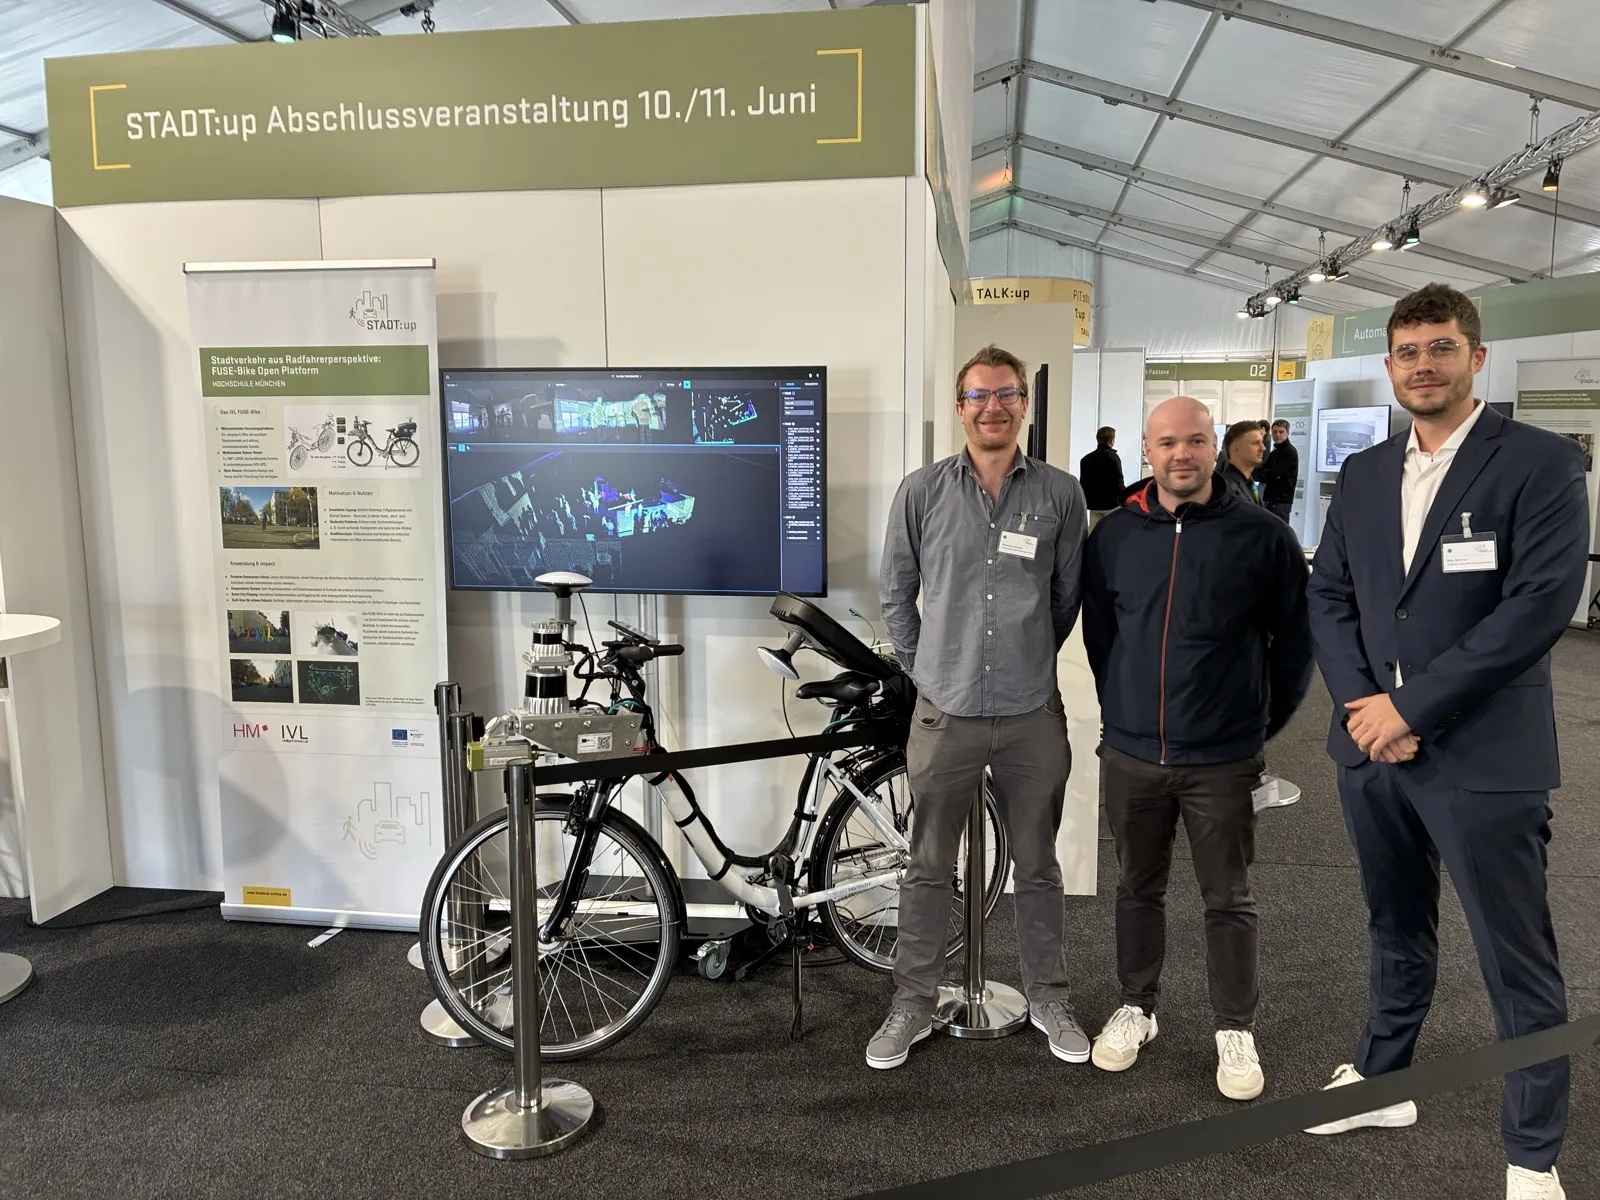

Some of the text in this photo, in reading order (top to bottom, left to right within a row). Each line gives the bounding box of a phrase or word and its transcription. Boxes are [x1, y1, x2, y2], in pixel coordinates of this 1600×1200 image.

[126, 83, 817, 142] STADT:up Abschlussveranstaltung 10./11. Juni
[976, 287, 1030, 301] TALK:up
[366, 319, 417, 332] STADT:up
[1353, 327, 1388, 340] Automa
[210, 353, 381, 366] Stadtverkehr aus Radfahrerperspektive:
[211, 365, 319, 377] FUSE-Bike Open Platform
[1250, 364, 1267, 377] 02
[254, 379, 286, 387] MÜNCHEN
[233, 723, 309, 740] HM IVL
